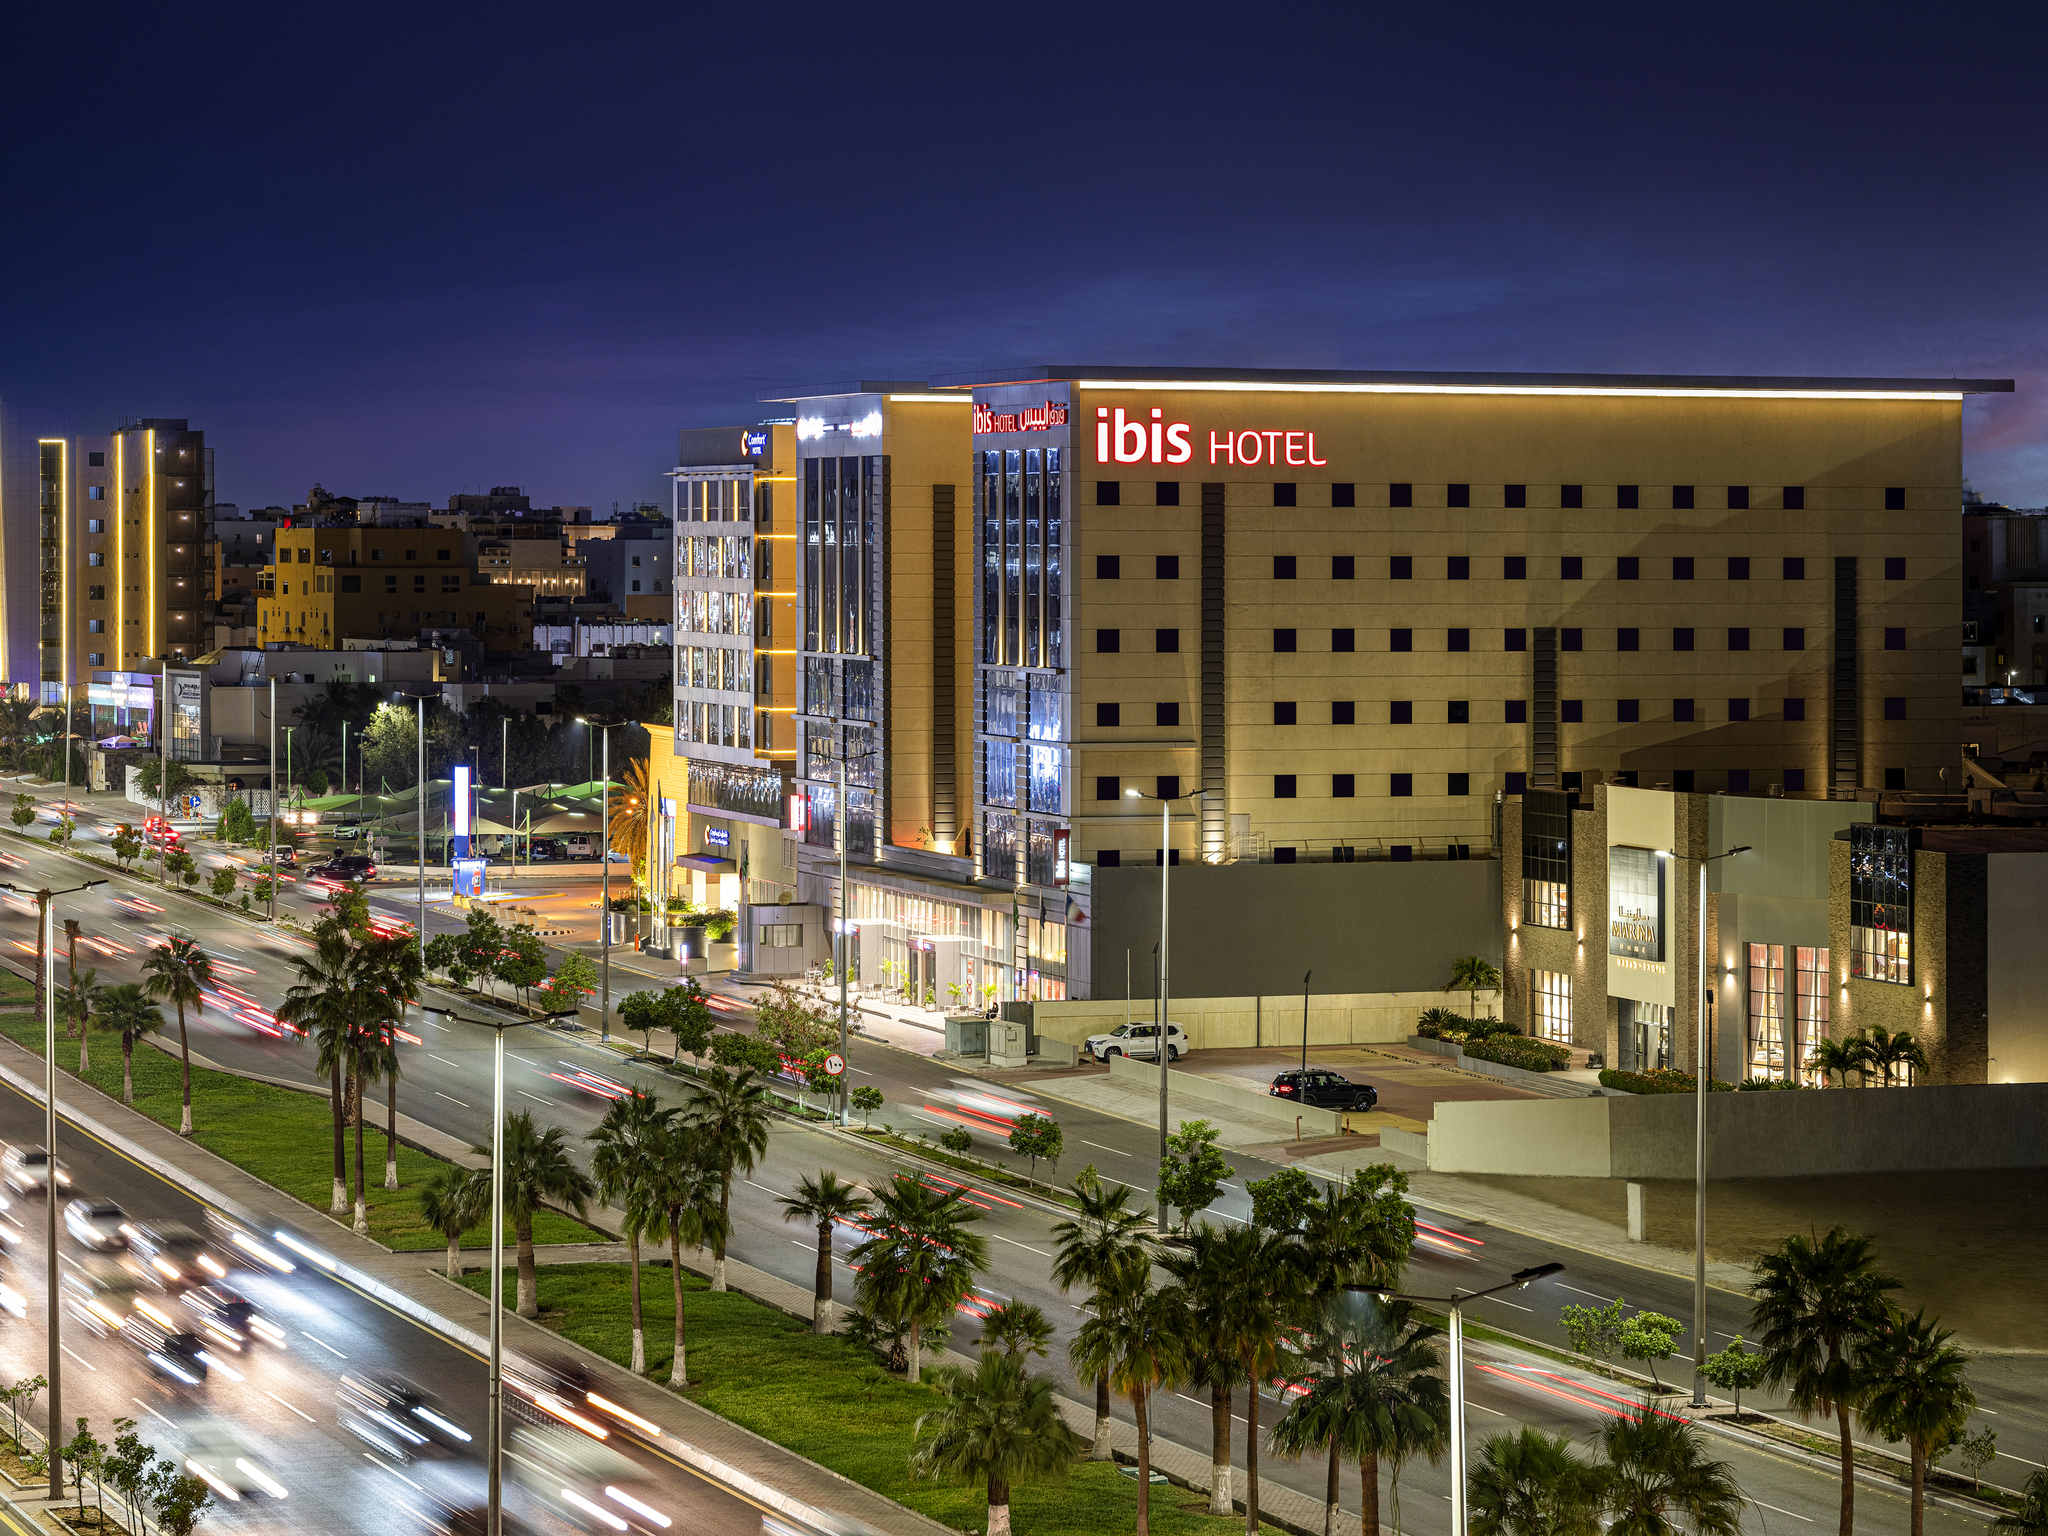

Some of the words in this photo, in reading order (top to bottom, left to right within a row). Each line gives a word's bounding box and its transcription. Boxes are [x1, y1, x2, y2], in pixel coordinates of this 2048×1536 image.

[973, 403, 994, 434] ibis
[994, 414, 1018, 432] HOTEL
[1096, 407, 1193, 465] ibis
[1208, 430, 1328, 466] HOTEL
[1611, 920, 1657, 943] MARINA
